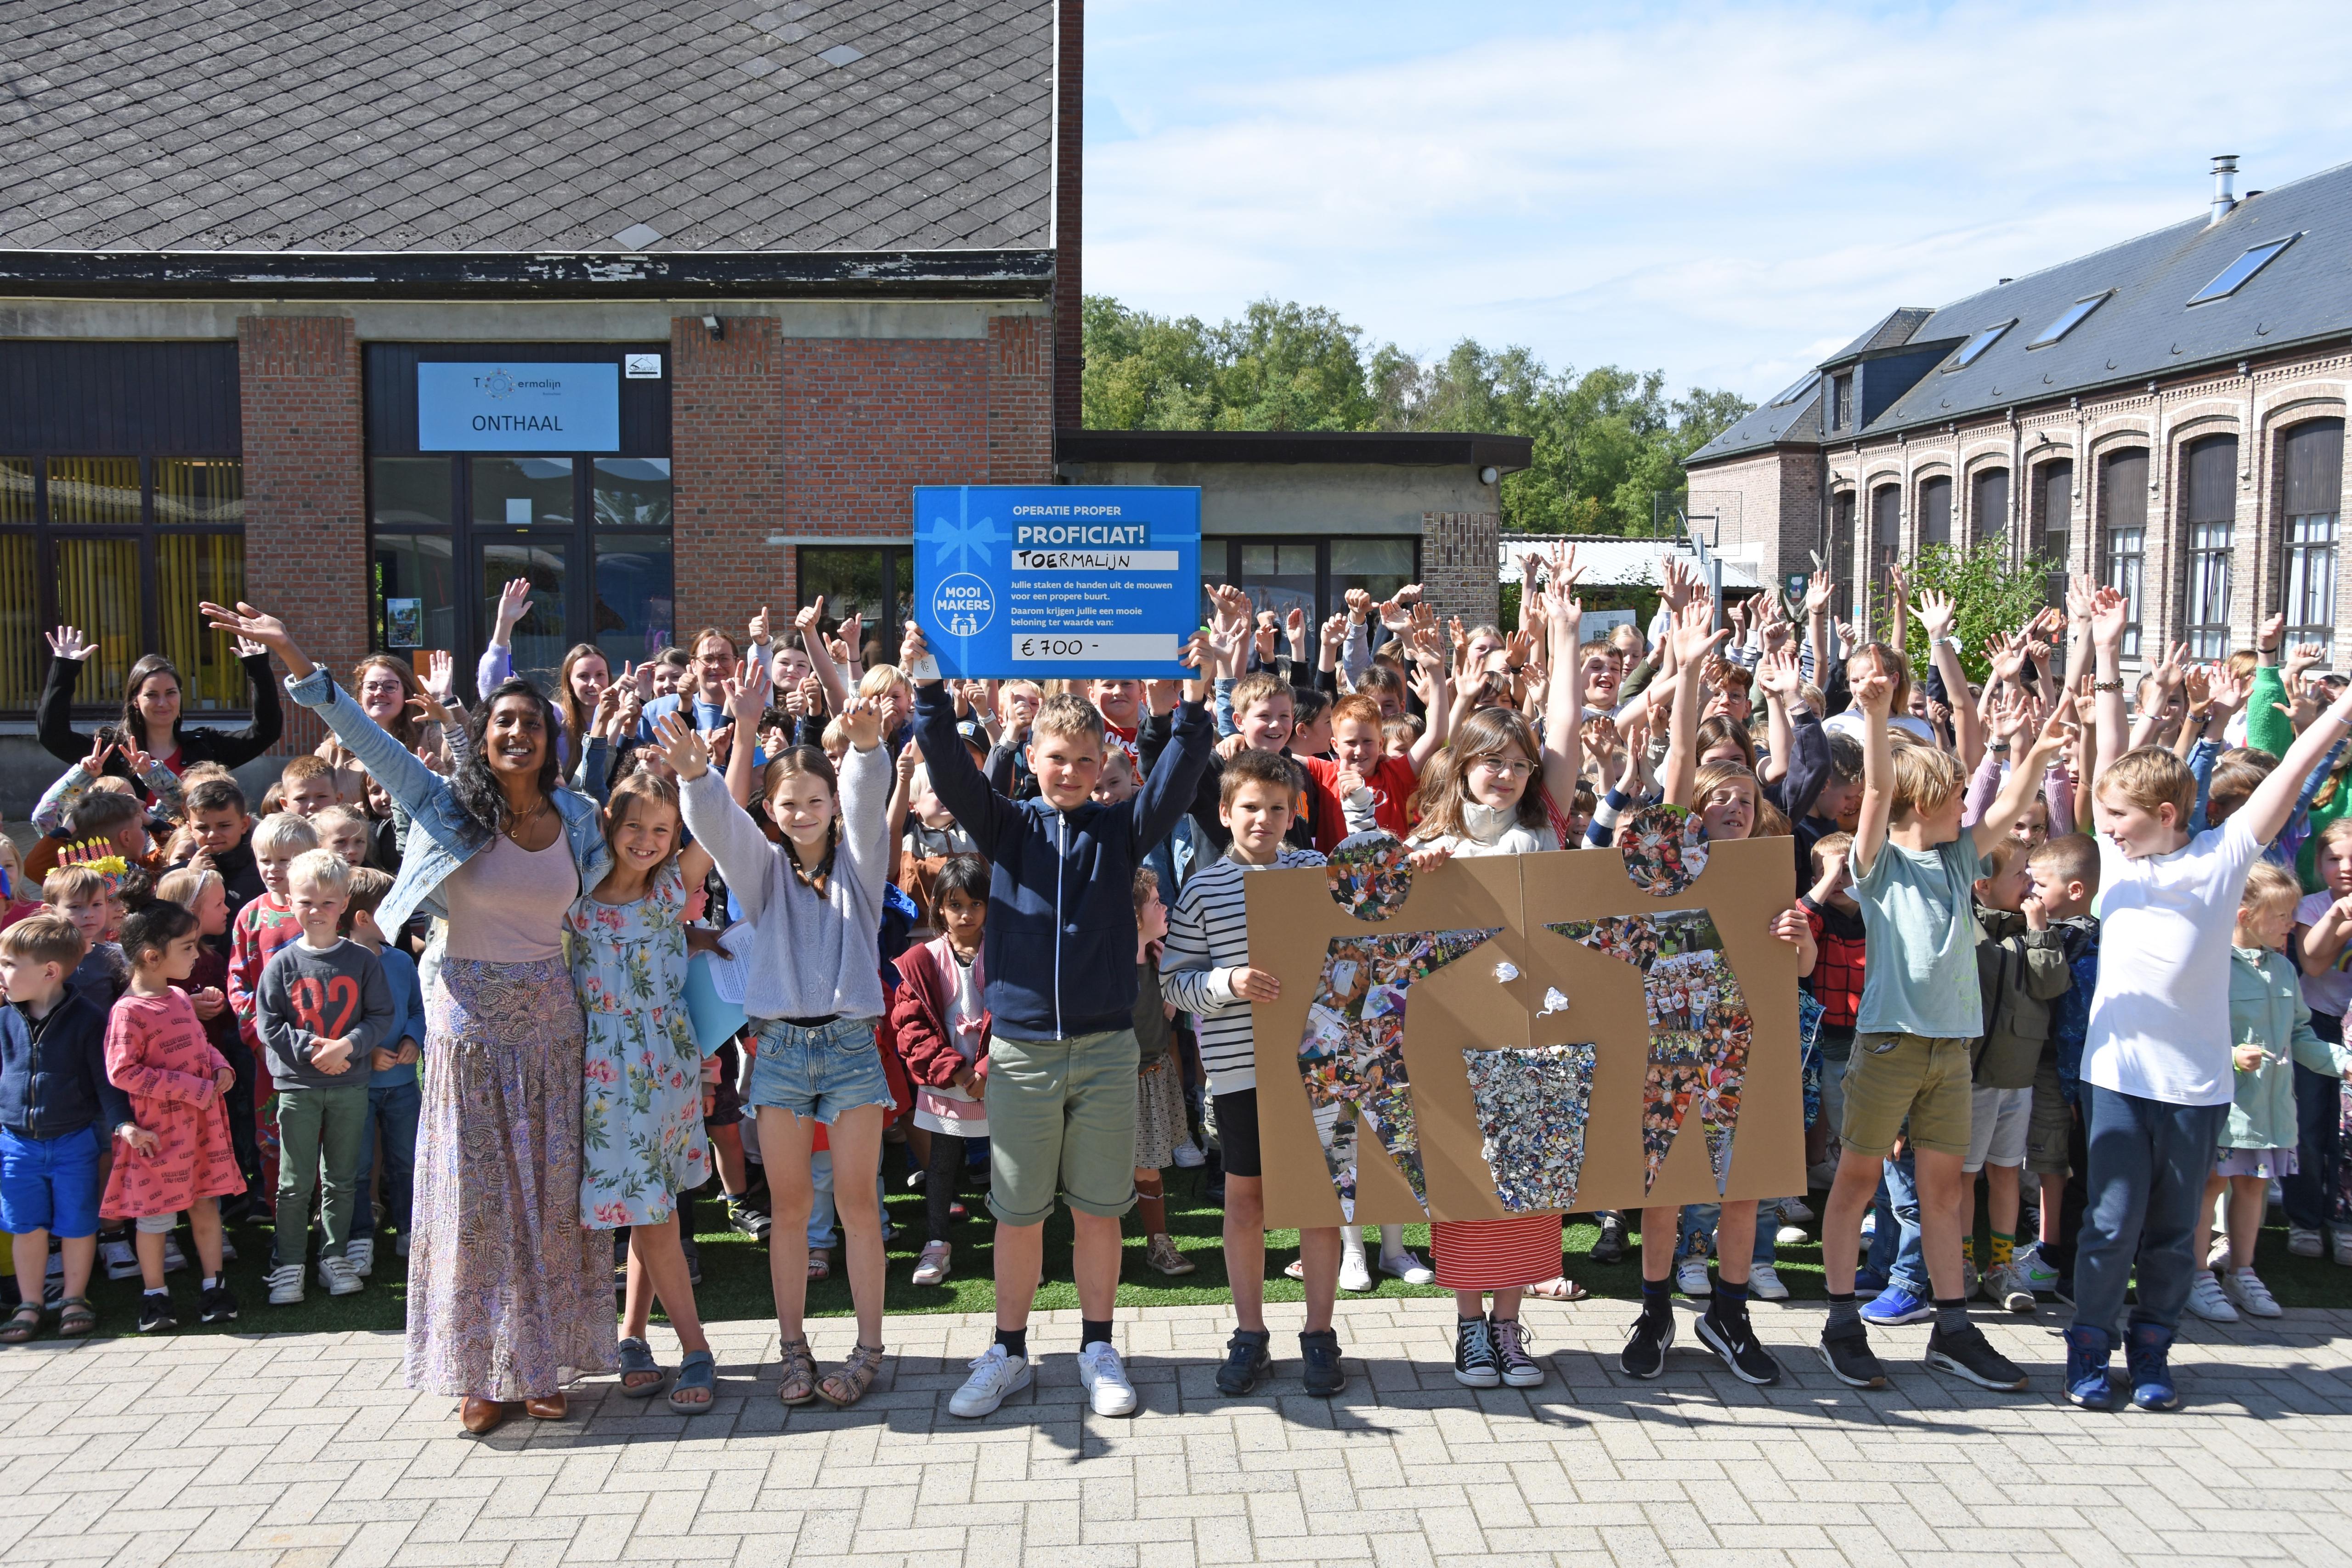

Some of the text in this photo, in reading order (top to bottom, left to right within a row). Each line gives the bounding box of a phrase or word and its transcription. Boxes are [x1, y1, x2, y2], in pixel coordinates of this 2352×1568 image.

[472, 415, 563, 431] ONTHAAL
[1013, 506, 1121, 515] OPERATIE PROPER
[1018, 525, 1145, 544] PROFICIAT!
[1011, 581, 1031, 589] Jullie
[945, 587, 980, 598] MOOI
[1050, 594, 1082, 602] propere
[1084, 592, 1110, 600] buurt.
[937, 600, 990, 611] MAKERS
[1046, 607, 1074, 617] krijgen
[1076, 607, 1097, 617] jullie
[1011, 618, 1046, 628] beloning
[291, 976, 359, 1040] 82
